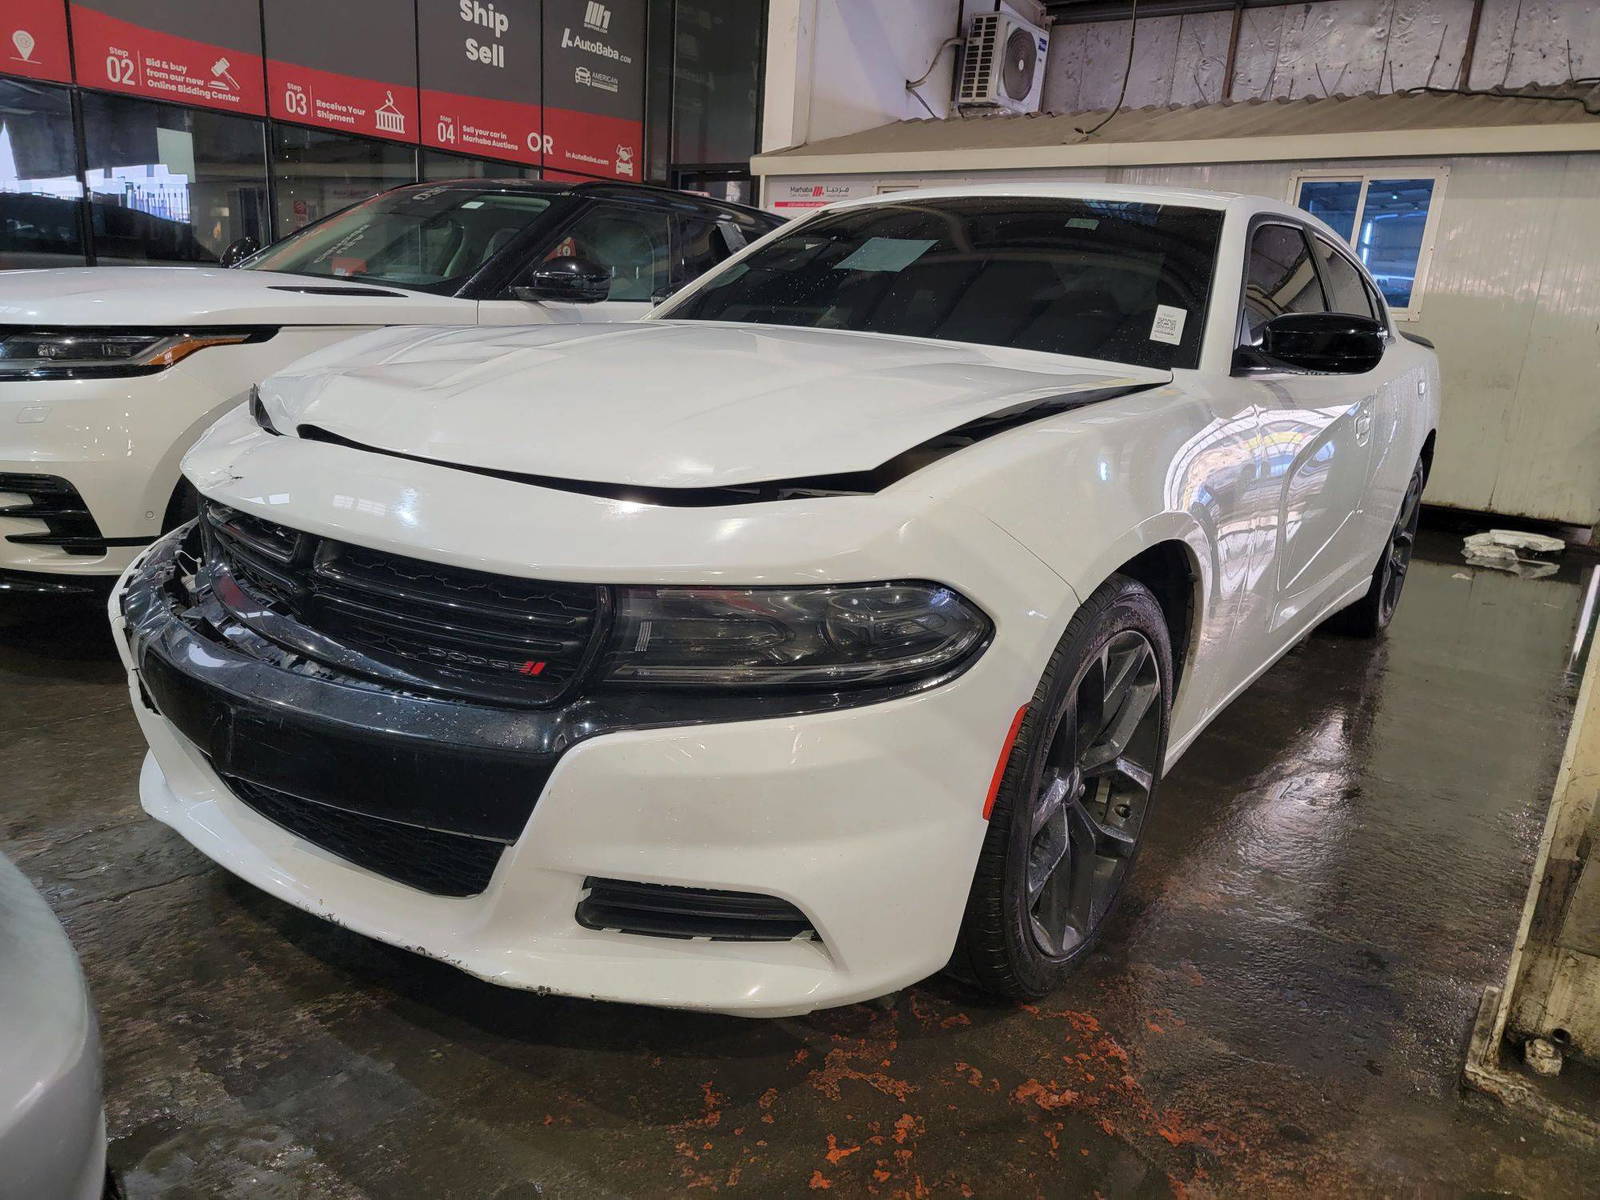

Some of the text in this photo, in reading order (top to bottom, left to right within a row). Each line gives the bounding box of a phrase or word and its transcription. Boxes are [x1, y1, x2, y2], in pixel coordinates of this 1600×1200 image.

[459, 0, 509, 38] Ship
[109, 46, 129, 58] Step
[465, 38, 505, 68] Sell
[106, 56, 136, 86] 02
[145, 57, 187, 75] Bid & buy
[146, 68, 205, 87] from our new
[147, 79, 240, 103] Online Bidding Center
[285, 90, 307, 116] 03
[316, 99, 366, 117] Receive Your
[316, 109, 355, 124] Shipment
[437, 122, 456, 145] 04
[462, 125, 507, 140] Sell your car in
[462, 134, 519, 151] Marhaba Auctions
[527, 132, 554, 156] OR
